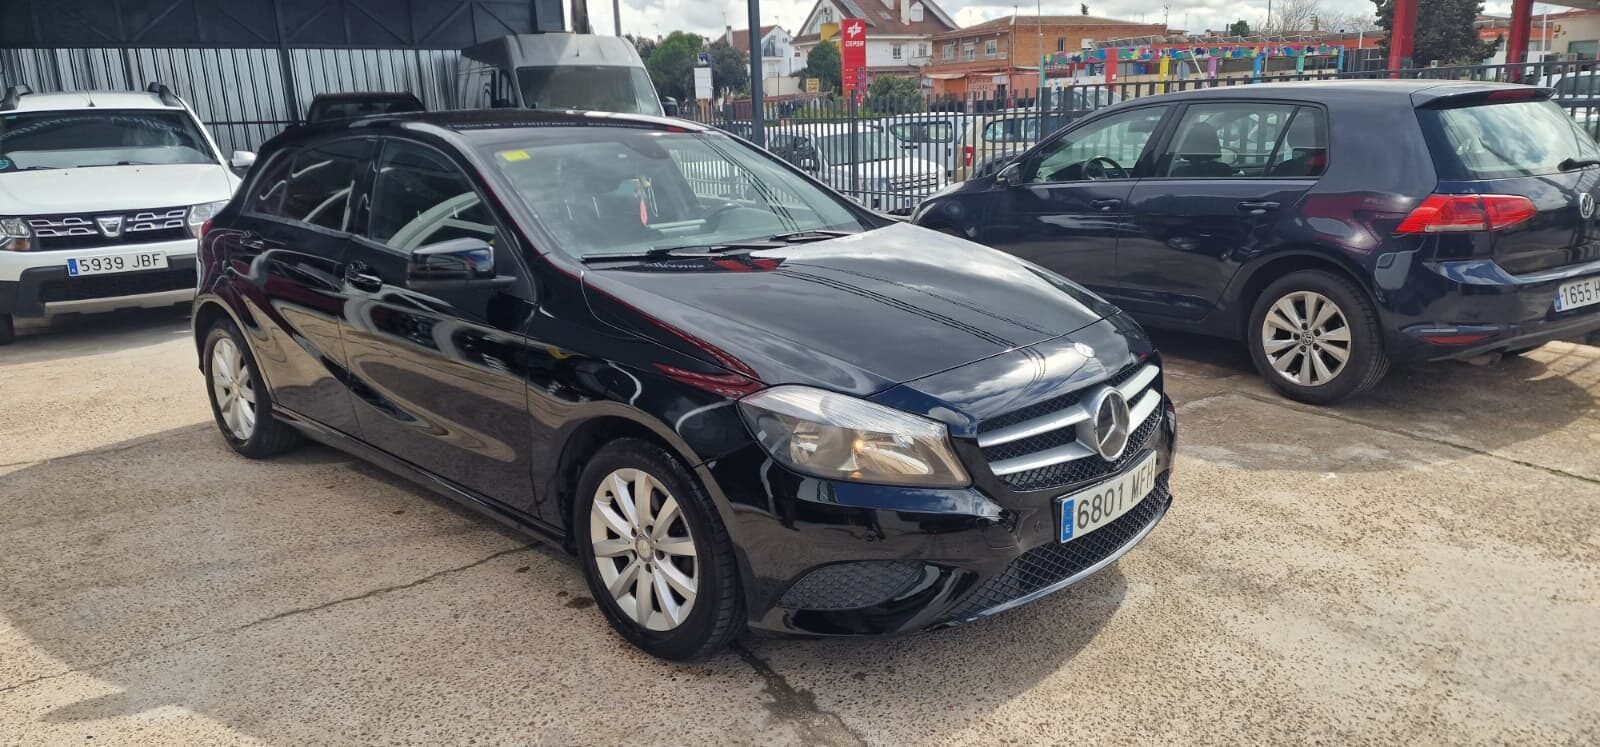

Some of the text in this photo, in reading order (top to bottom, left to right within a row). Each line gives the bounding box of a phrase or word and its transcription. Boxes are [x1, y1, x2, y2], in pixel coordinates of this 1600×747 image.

[79, 253, 161, 272] 5939 JBF
[1563, 282, 1592, 306] 1655
[1077, 483, 1124, 529] 6801
[1131, 458, 1154, 503] MFH
